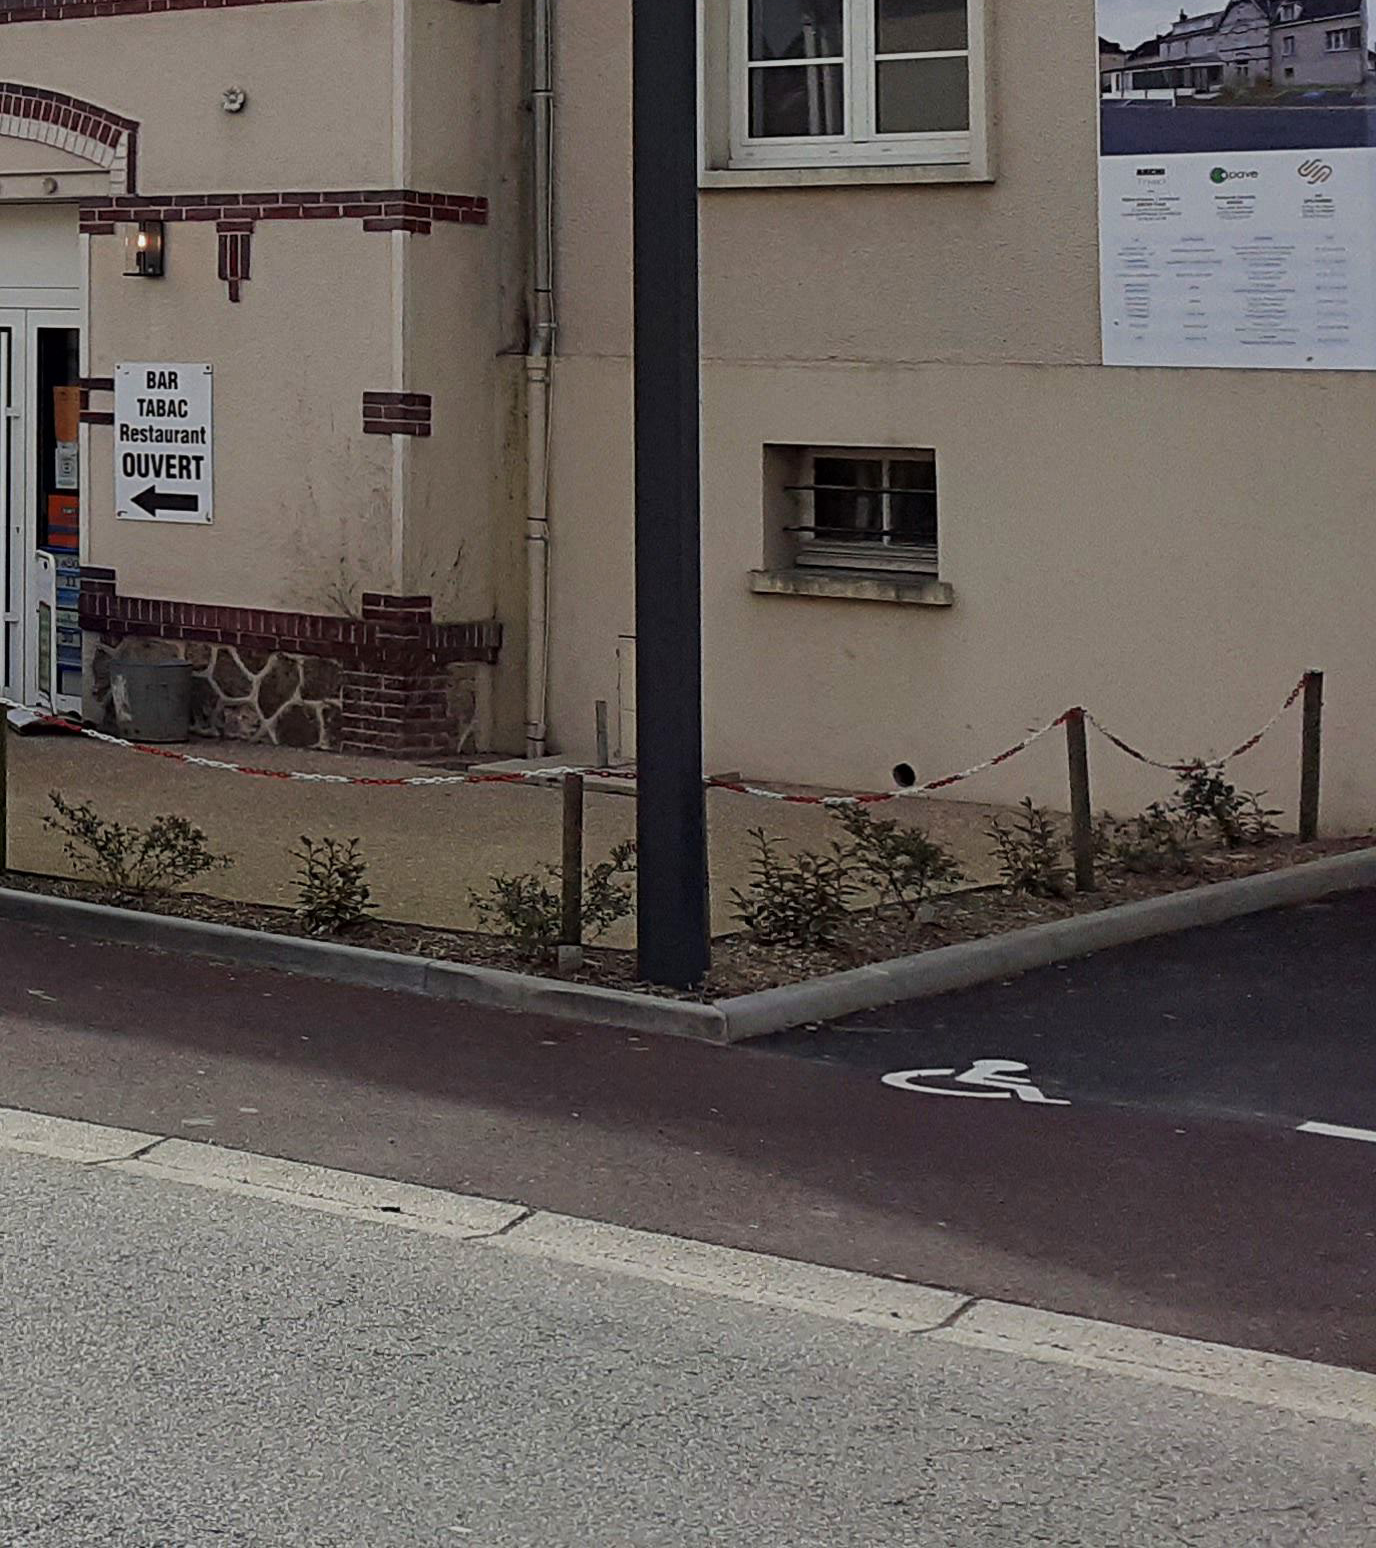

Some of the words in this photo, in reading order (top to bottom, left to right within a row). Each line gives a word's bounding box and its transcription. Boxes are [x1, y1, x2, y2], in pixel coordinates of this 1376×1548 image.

[146, 370, 178, 390] BAR
[136, 398, 188, 418] TABAC
[119, 423, 206, 444] Restaurant
[122, 452, 204, 480] OUVERT
